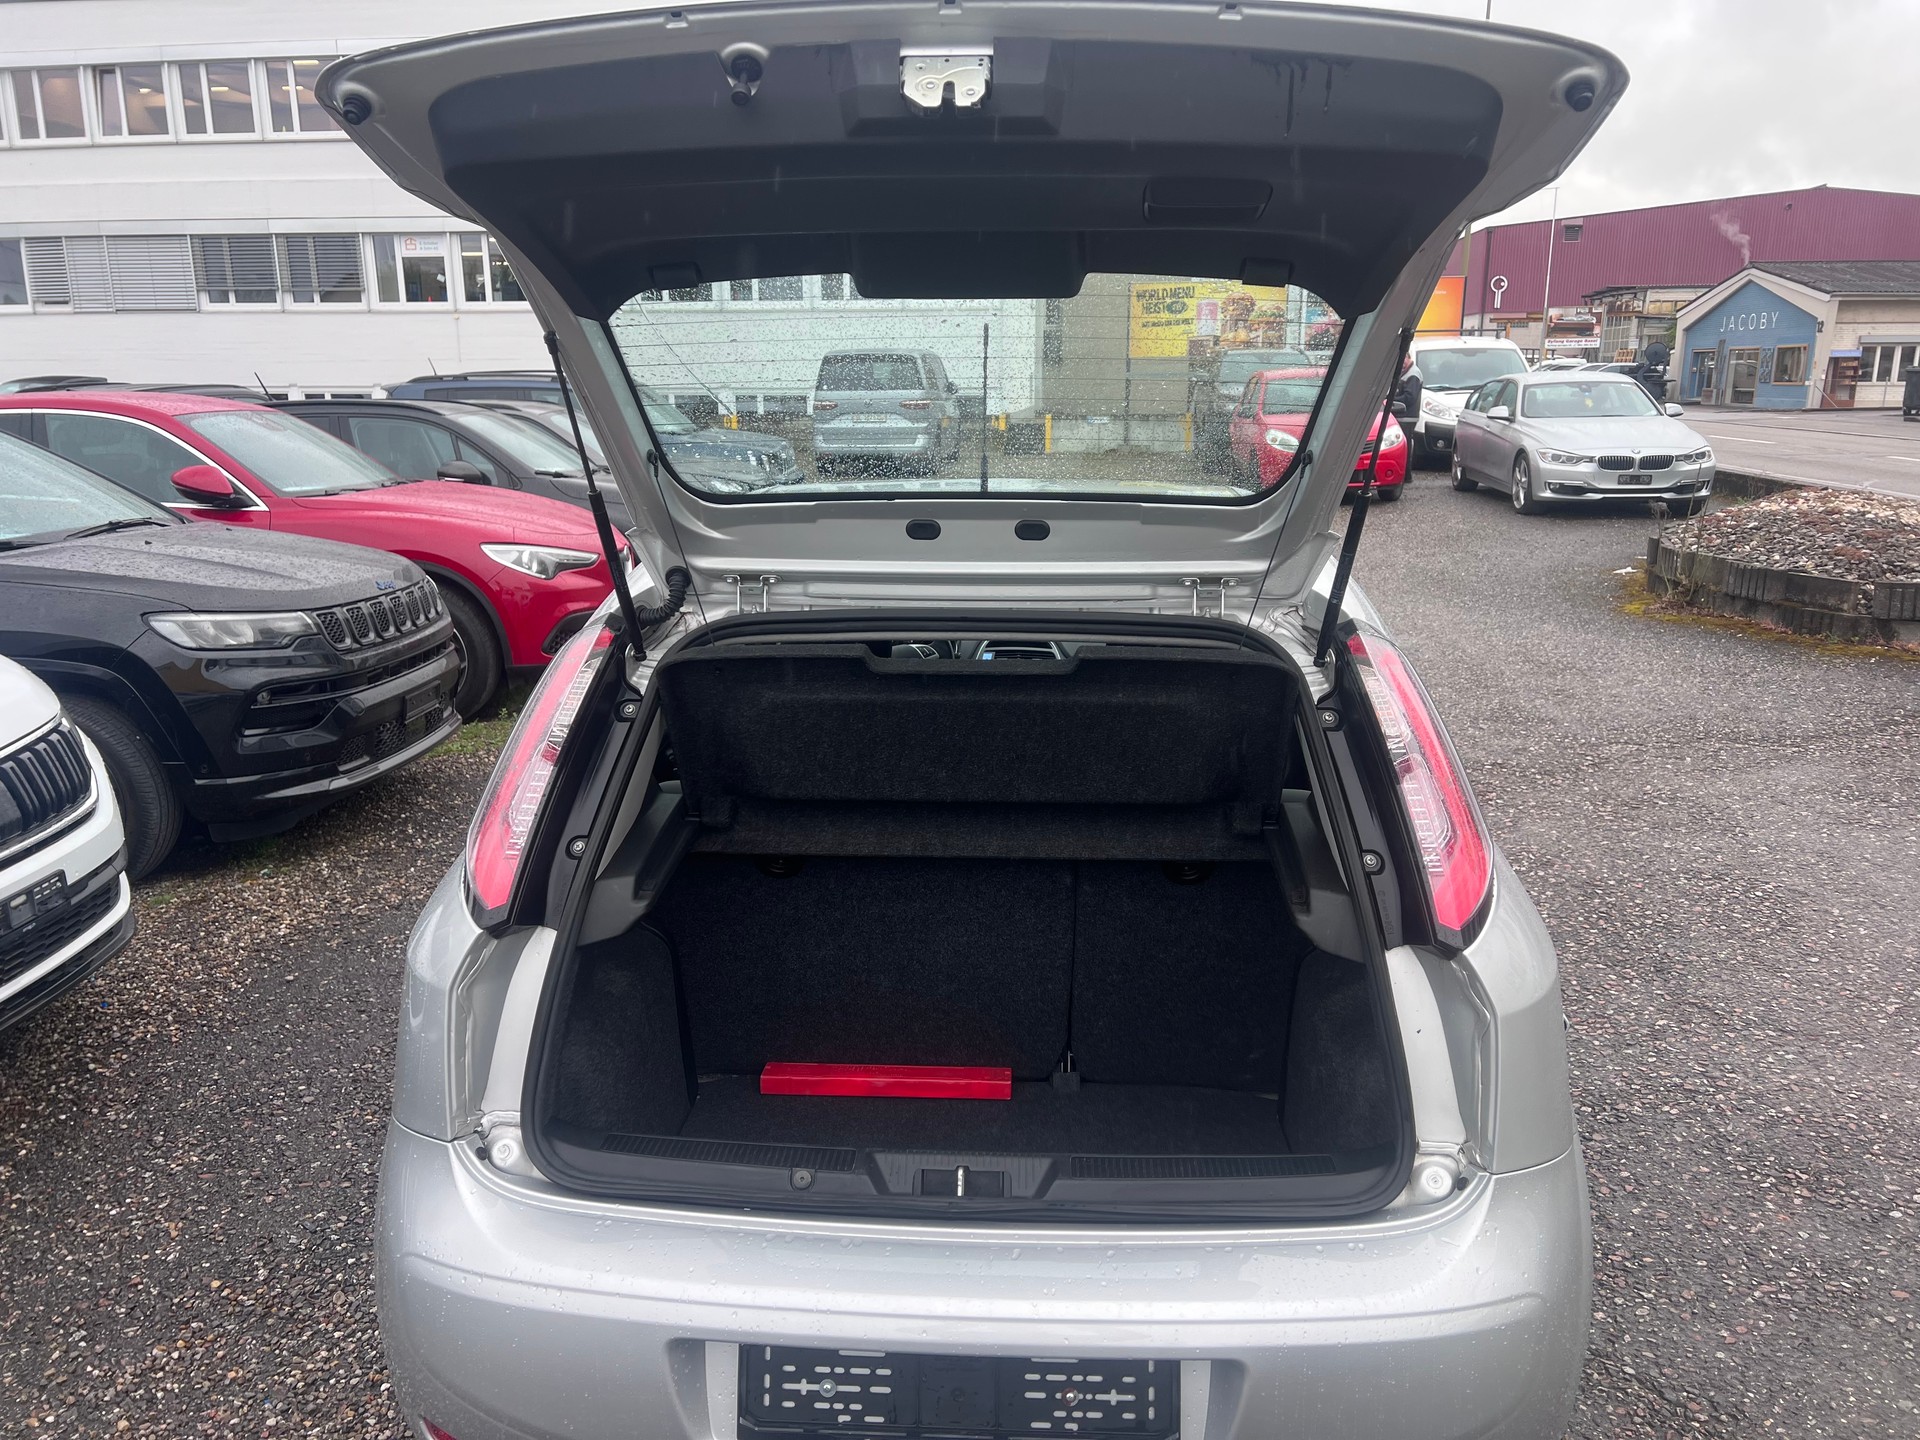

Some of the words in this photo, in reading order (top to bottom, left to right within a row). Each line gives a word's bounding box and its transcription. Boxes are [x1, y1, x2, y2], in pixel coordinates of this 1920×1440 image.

[1136, 288, 1168, 302] WORLD
[1169, 286, 1195, 300] MENU
[1720, 311, 1779, 332] JACOBY
[1816, 320, 1825, 333] 12
